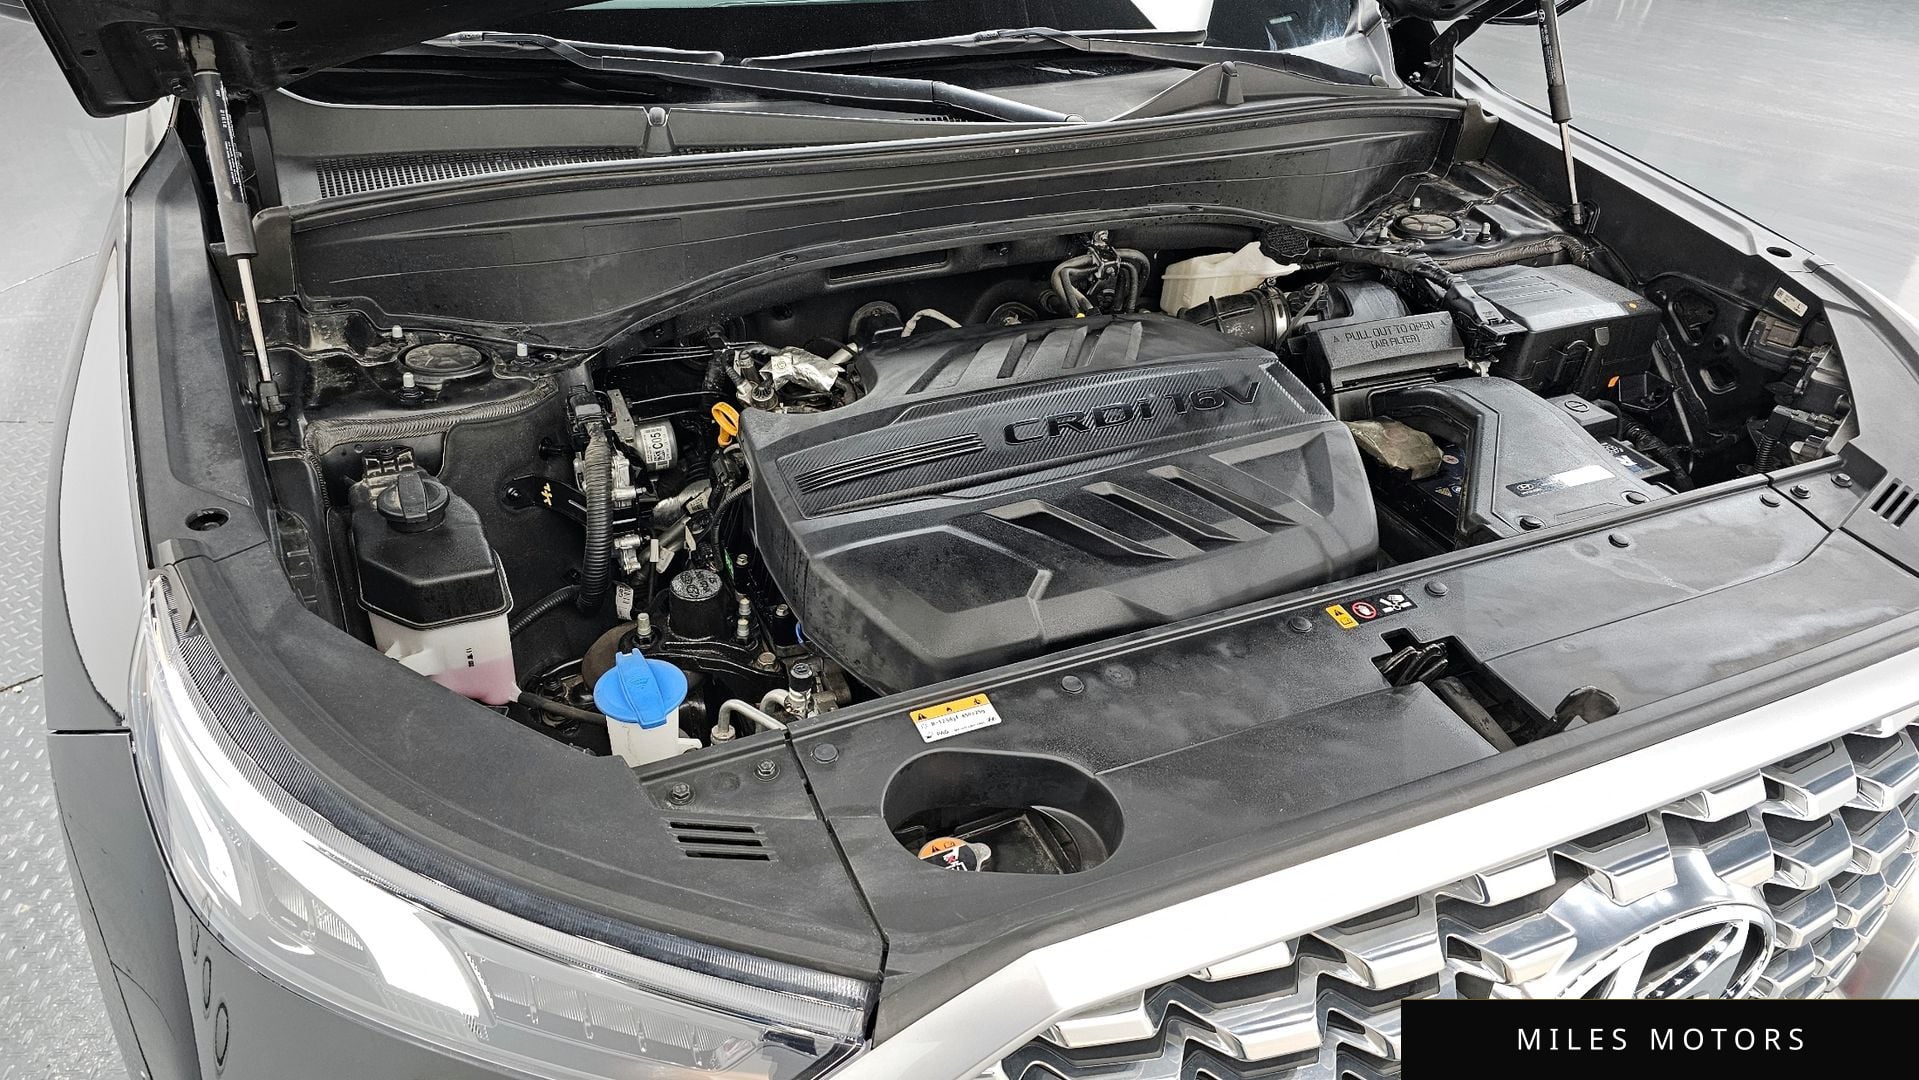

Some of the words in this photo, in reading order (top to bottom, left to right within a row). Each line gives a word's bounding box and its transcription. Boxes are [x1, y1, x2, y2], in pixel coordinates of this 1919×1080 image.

[1344, 330, 1372, 341] PULL
[1373, 326, 1393, 336] OUT
[1395, 324, 1408, 334] TO
[1409, 321, 1435, 332] OPEN
[1164, 381, 1261, 415] 16V
